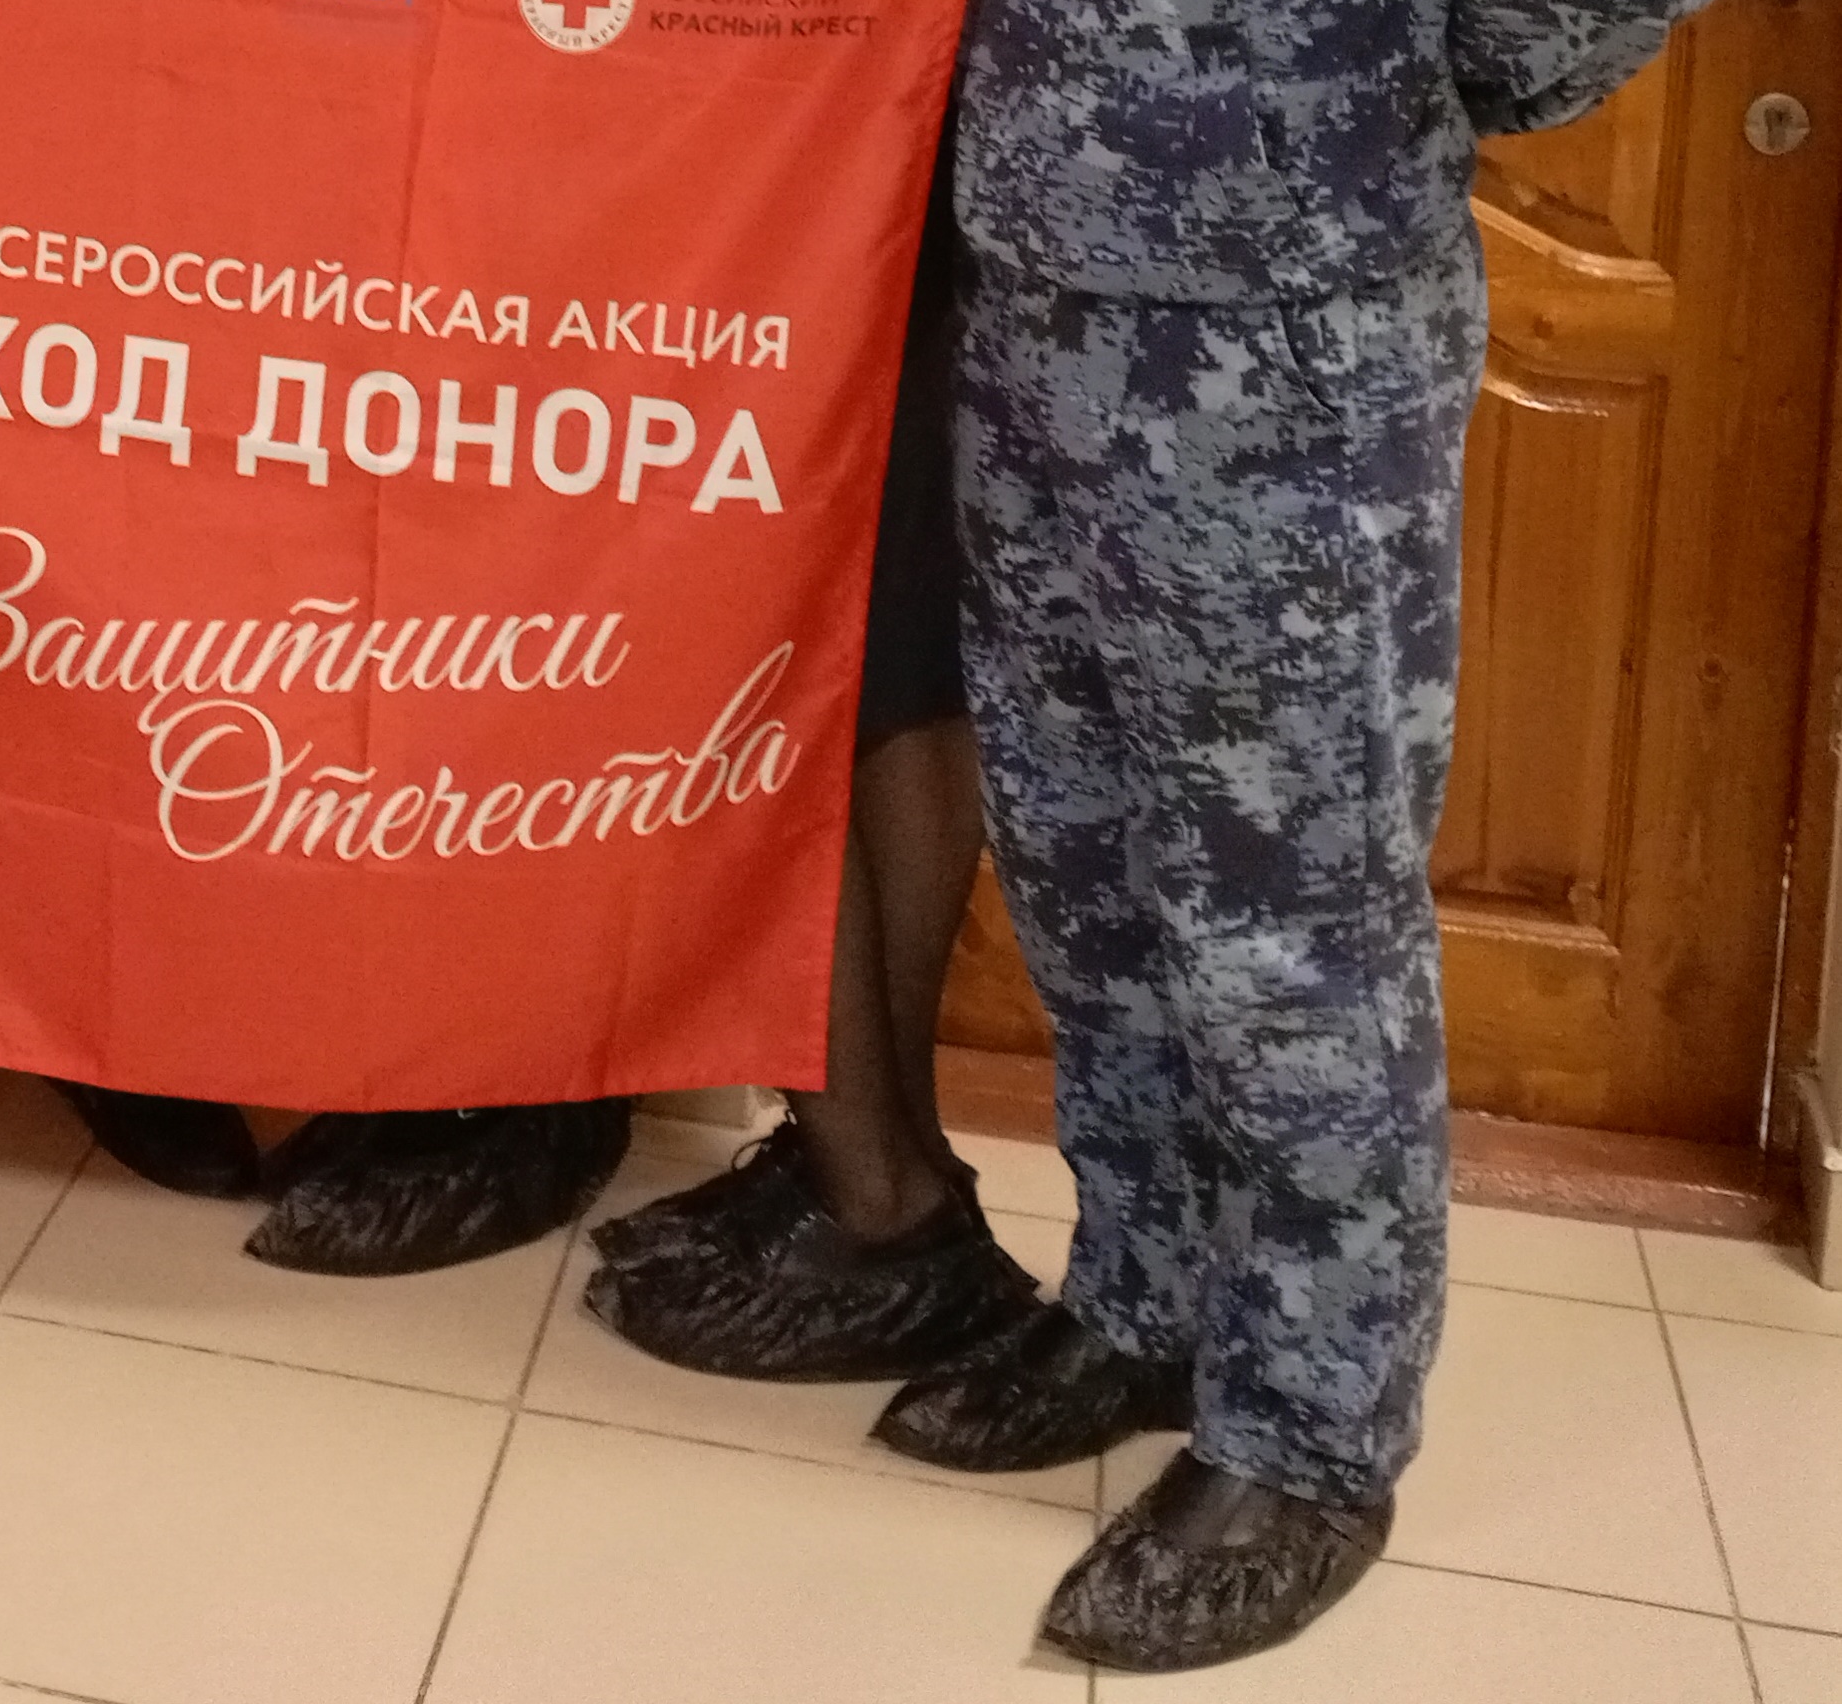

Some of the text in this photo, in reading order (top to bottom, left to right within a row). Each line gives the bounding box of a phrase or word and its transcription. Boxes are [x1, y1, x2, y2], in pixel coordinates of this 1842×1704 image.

[649, 9, 880, 38] КРАСНЫЙ КРЕСТ
[549, 298, 792, 372] АКЦИЯ
[235, 354, 785, 516] ДОНОРА
[148, 640, 803, 863] Отечества
